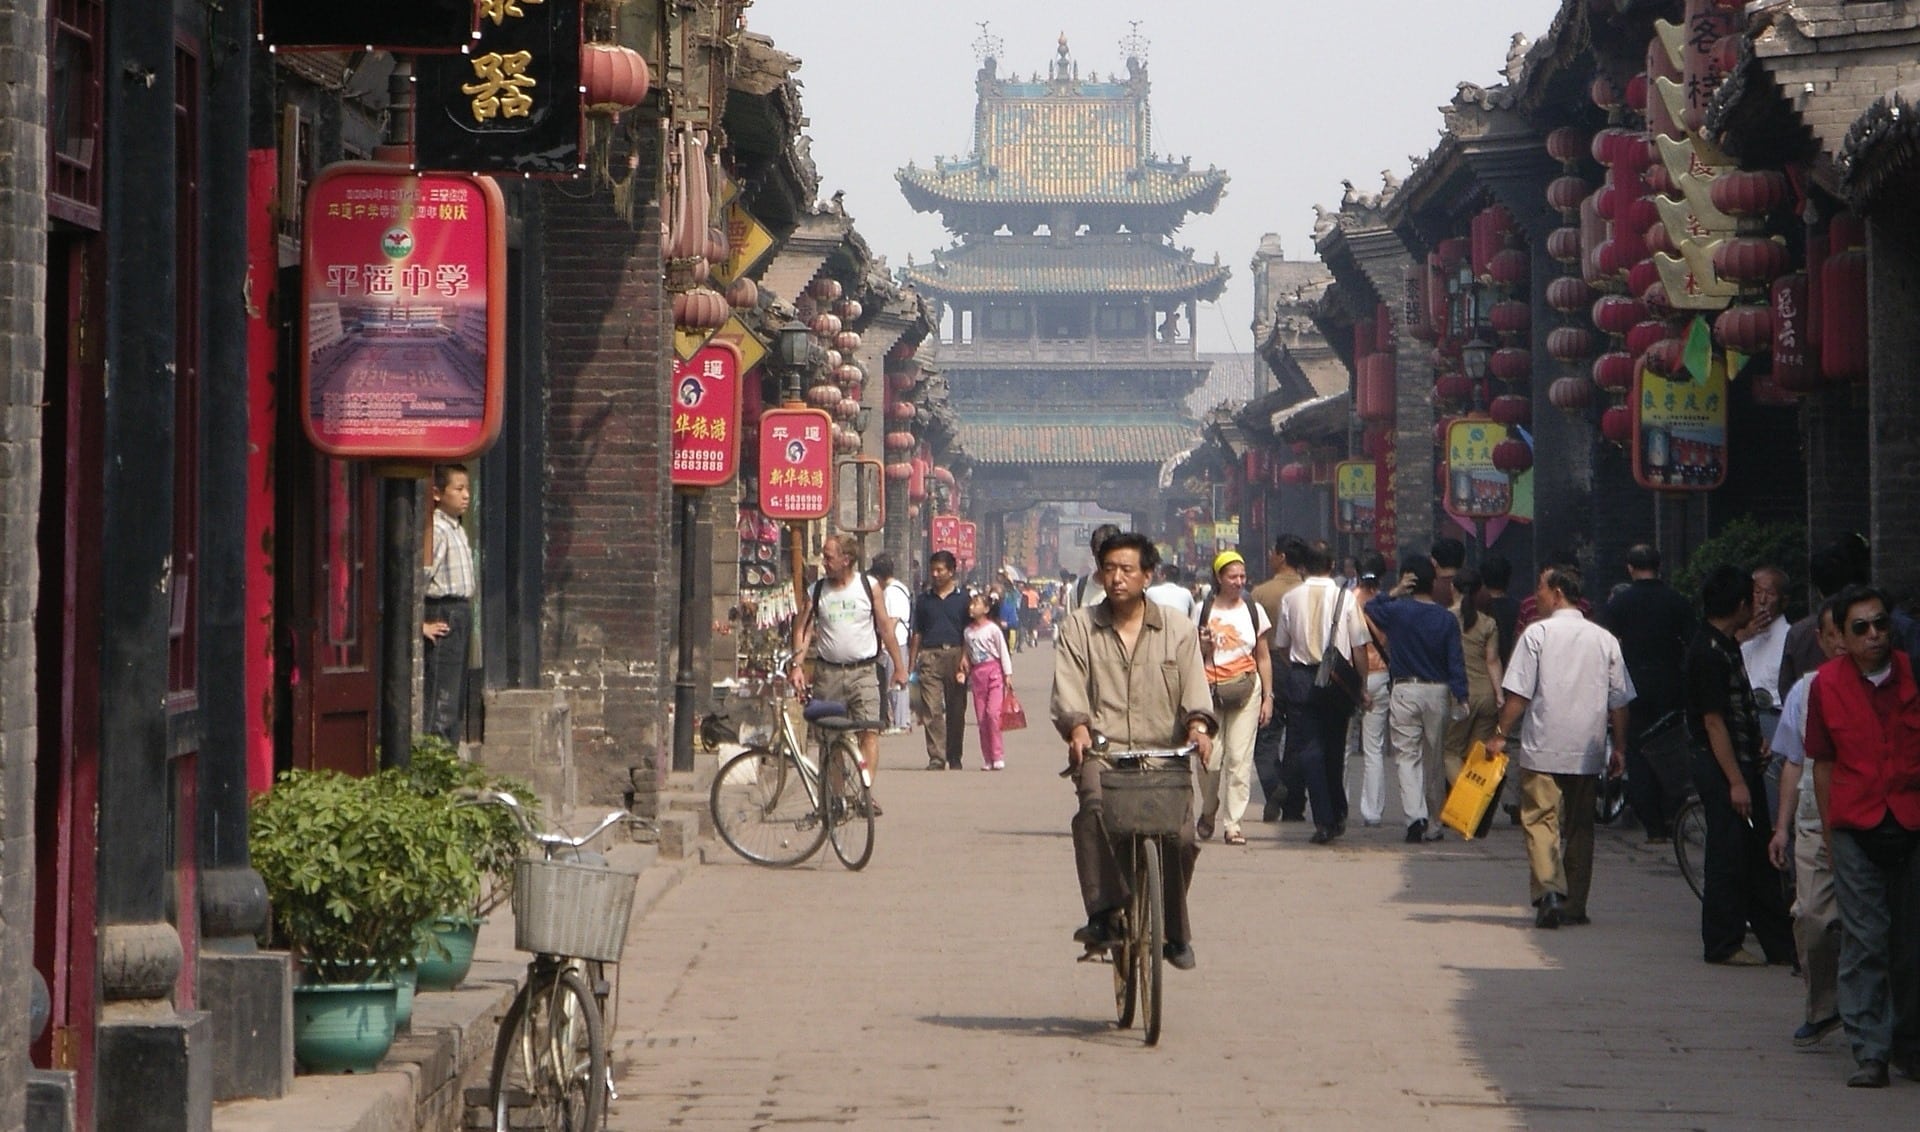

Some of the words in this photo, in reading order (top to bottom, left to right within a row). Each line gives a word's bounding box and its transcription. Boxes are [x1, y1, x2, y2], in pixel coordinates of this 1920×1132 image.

[326, 263, 469, 297] 平遥中学
[673, 414, 727, 442] 华旅游
[674, 449, 724, 461] 5636900
[673, 460, 724, 472] 5683888
[769, 467, 824, 488] 新华旅游
